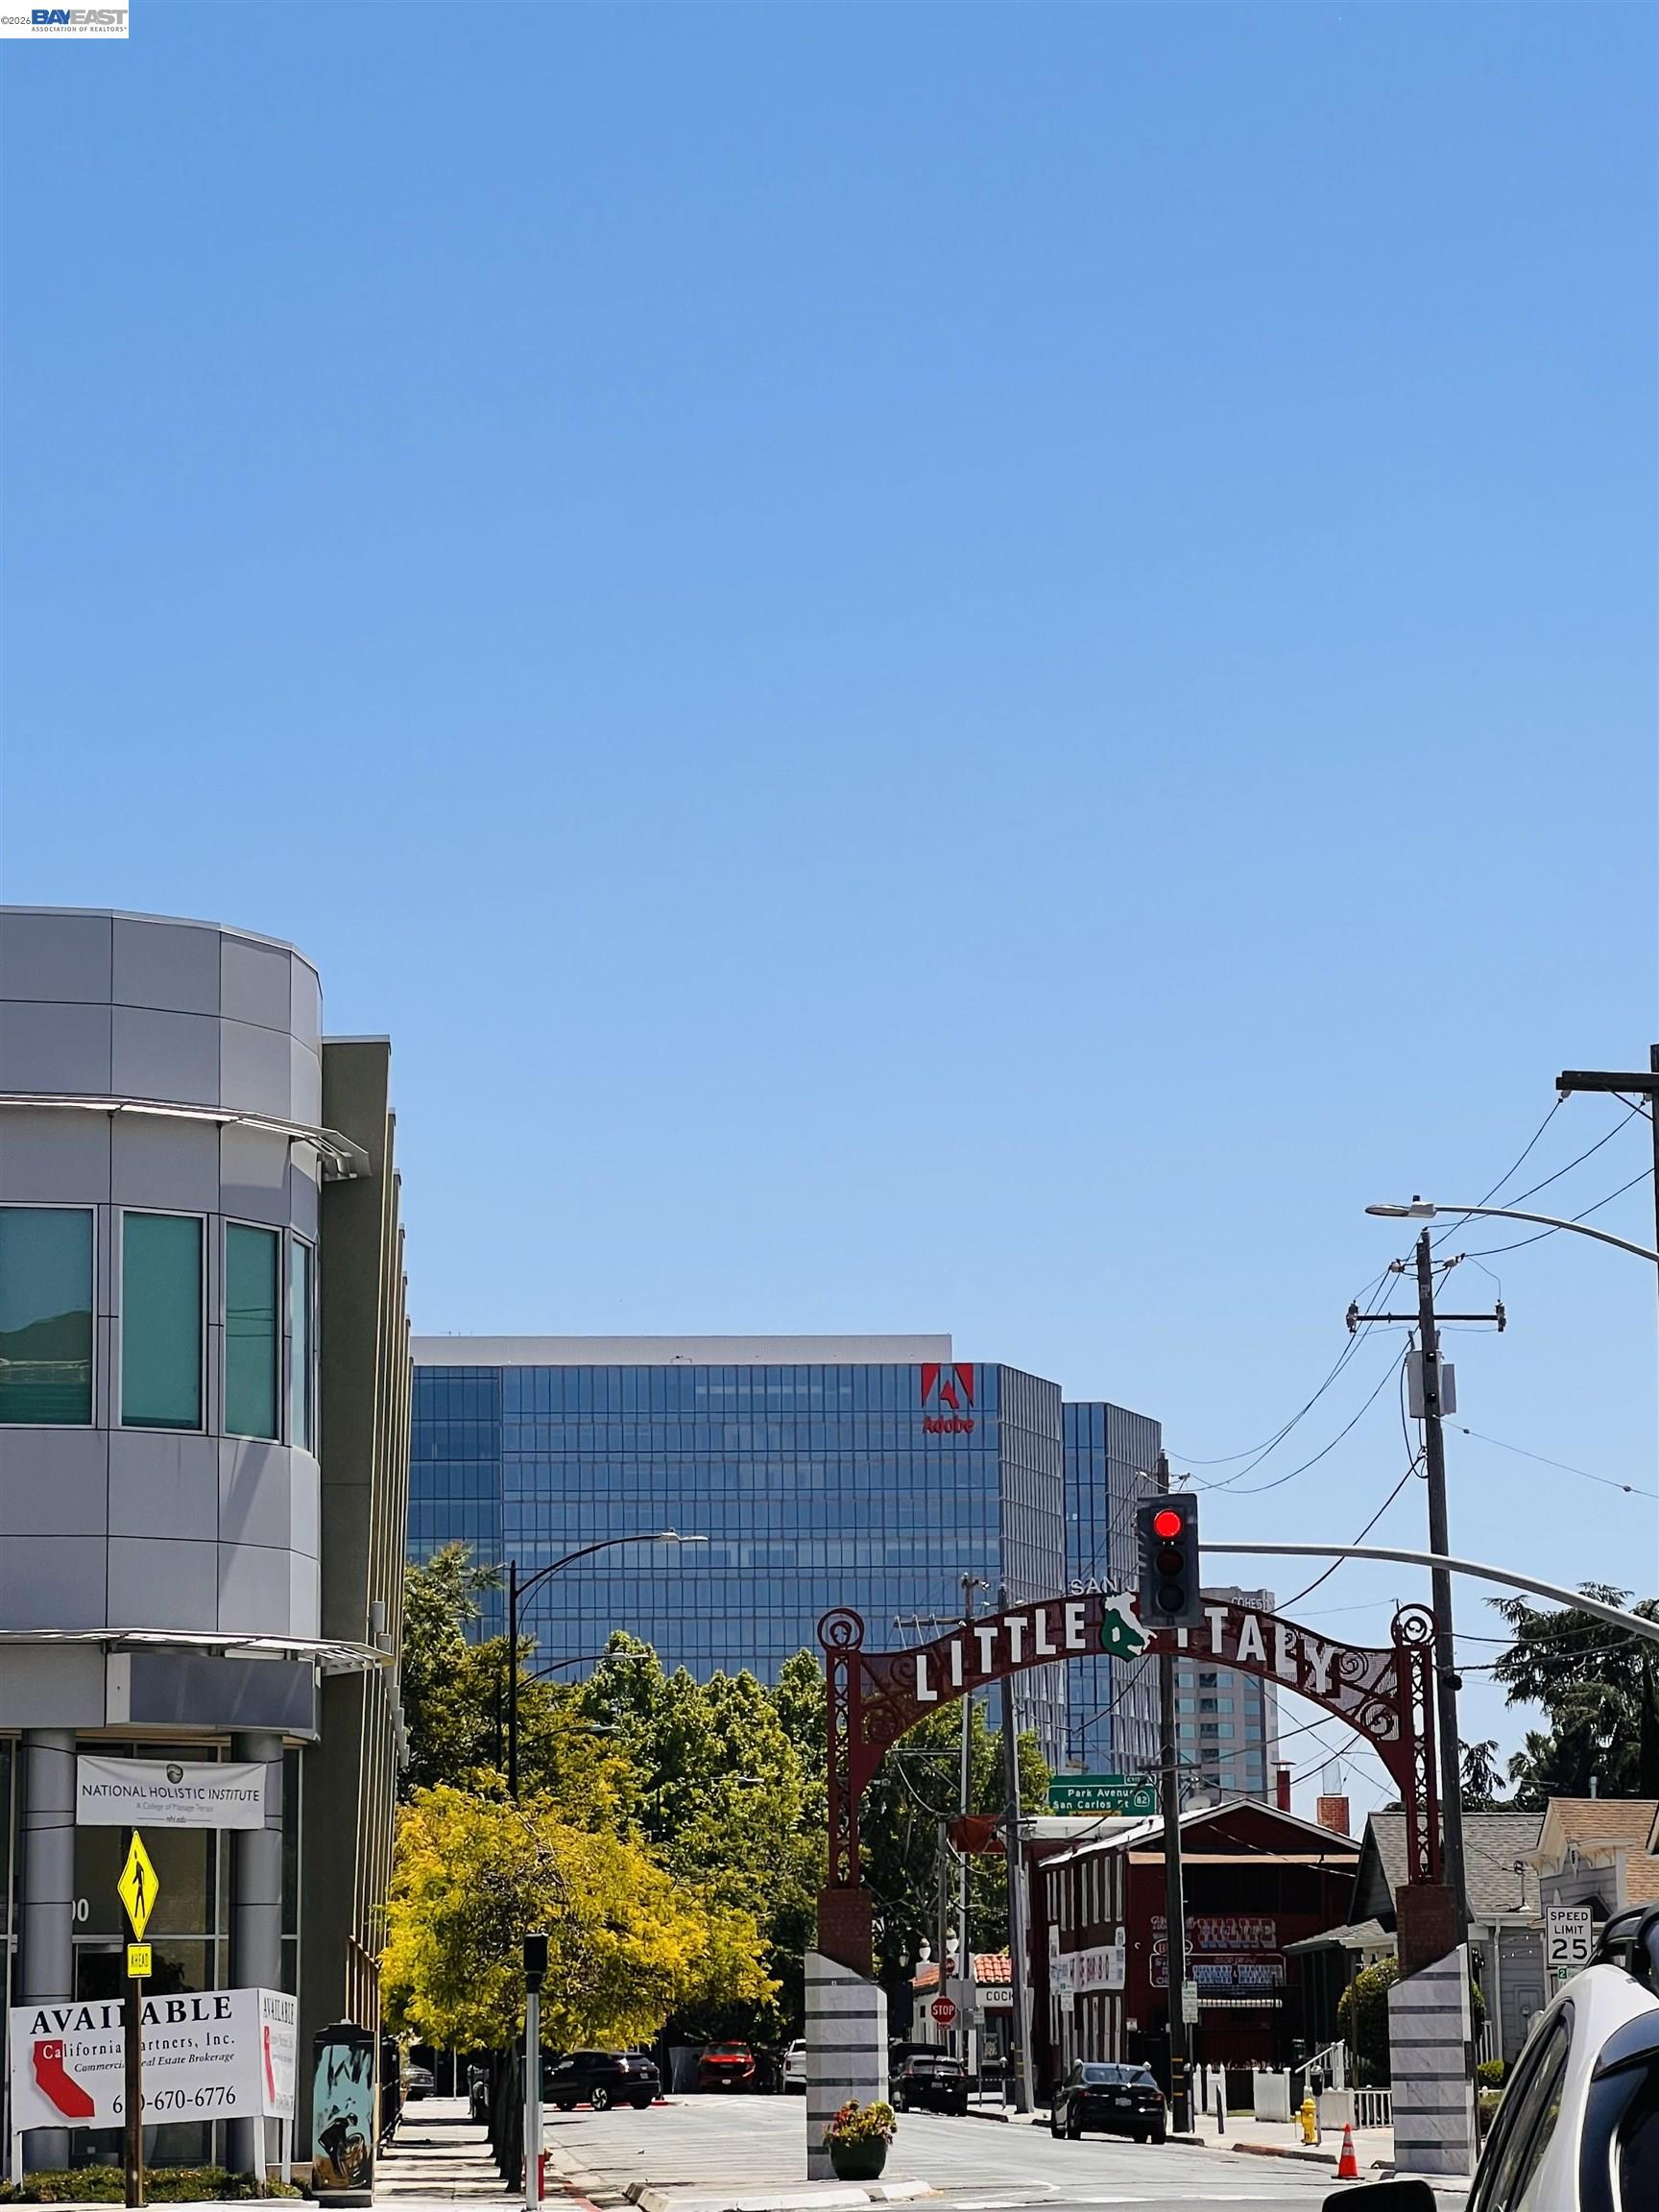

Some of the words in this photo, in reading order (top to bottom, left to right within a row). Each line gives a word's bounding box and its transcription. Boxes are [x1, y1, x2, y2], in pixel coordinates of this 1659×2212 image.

[923, 1414, 974, 1434] Adobe
[1070, 1576, 1118, 1596] SAN
[916, 1602, 1087, 1701] LITTLE
[82, 1784, 146, 1798] NATIONAL
[149, 1787, 205, 1800] HOLISTIC
[208, 1789, 260, 1802] INSTITUTE
[1068, 1789, 1093, 1797] Park
[1136, 1795, 1148, 1805] 82
[1053, 1800, 1072, 1810] San
[1077, 1800, 1111, 1809] Carlos
[1551, 1911, 1588, 1921] SPEED
[1554, 1925, 1584, 1935] LIMIT
[1551, 1938, 1588, 1960] 25
[932, 2005, 955, 2016] STOP
[43, 2040, 122, 2059] California
[141, 2038, 199, 2051] artners,
[205, 2032, 235, 2046] Inc.
[74, 2060, 125, 2073] Commerci
[141, 2056, 156, 2067] eal
[157, 2056, 186, 2066] Estate
[188, 2053, 235, 2063] Brokerage
[112, 2085, 236, 2113] 6-670-6776
